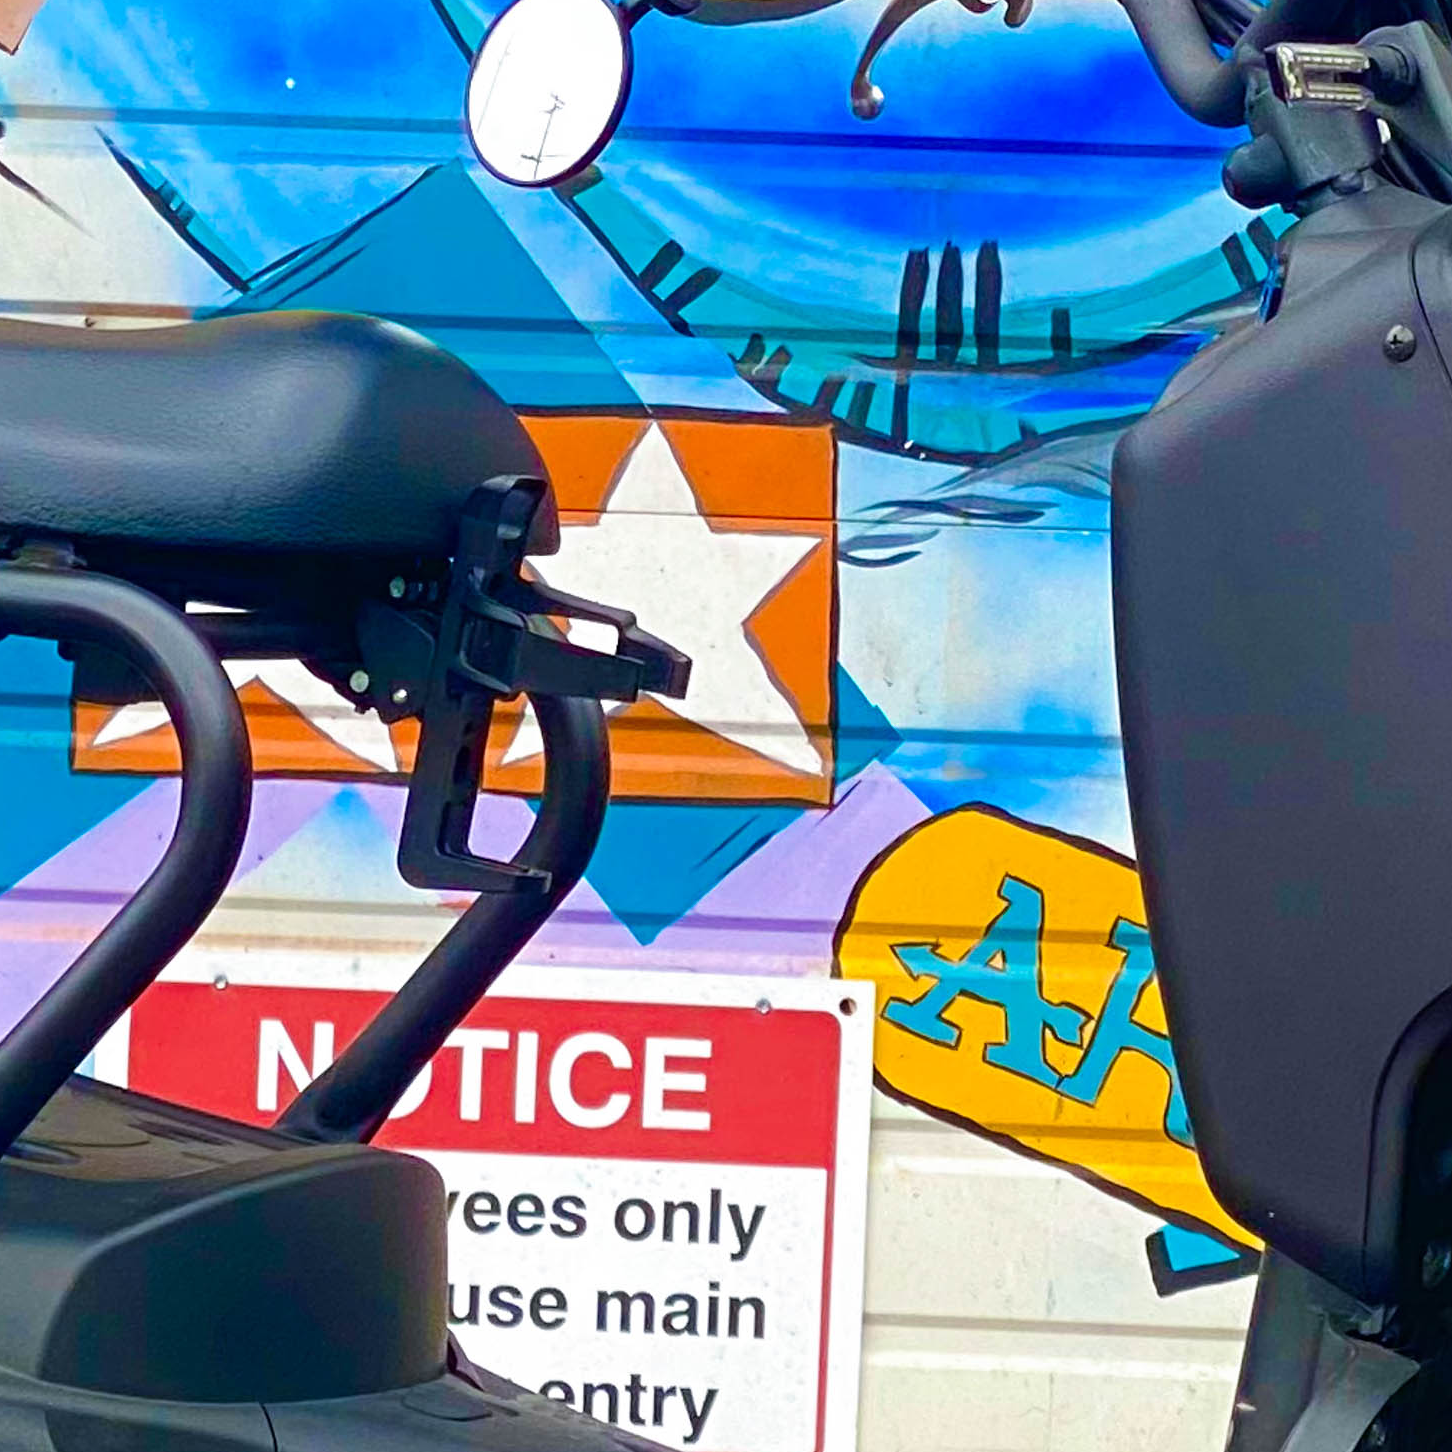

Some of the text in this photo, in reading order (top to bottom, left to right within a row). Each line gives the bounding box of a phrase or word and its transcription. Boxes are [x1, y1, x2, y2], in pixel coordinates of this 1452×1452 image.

[257, 1019, 713, 1131] NTICE
[613, 1188, 767, 1262] only
[448, 1281, 766, 1339] use main
[538, 1373, 720, 1444] entry
